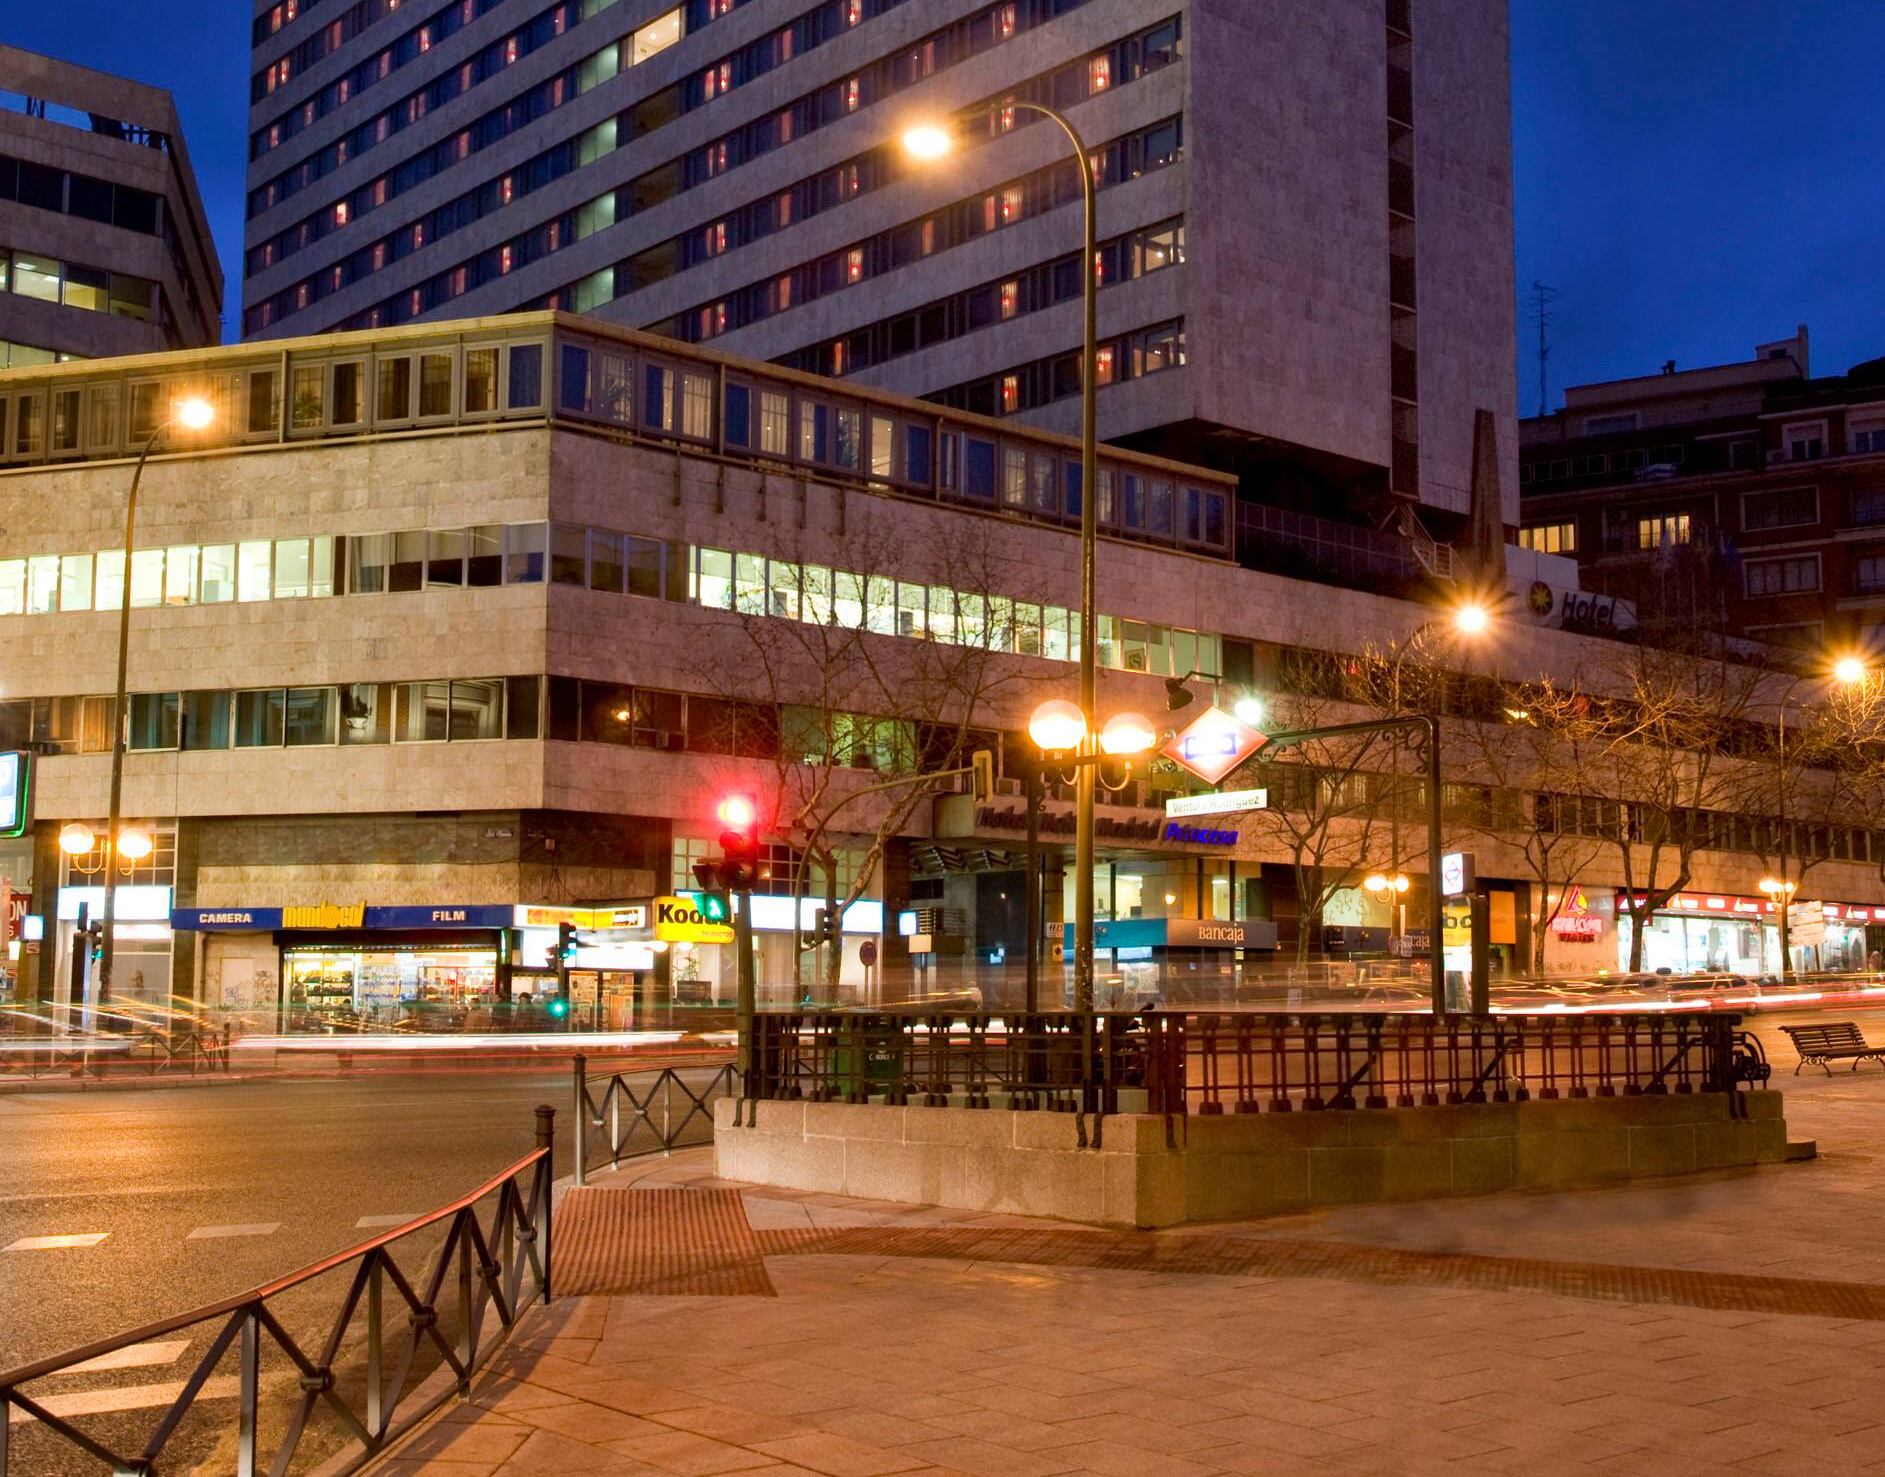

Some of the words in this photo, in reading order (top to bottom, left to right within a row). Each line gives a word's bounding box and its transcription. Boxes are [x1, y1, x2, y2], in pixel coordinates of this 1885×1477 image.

[1561, 591, 1617, 624] Hotel
[975, 805, 1029, 831] Hote
[1166, 822, 1239, 845] Princesa
[199, 912, 252, 923] CAMERA
[432, 910, 466, 922] FILM
[658, 904, 722, 925] Kod
[1198, 923, 1244, 945] Bancaja
